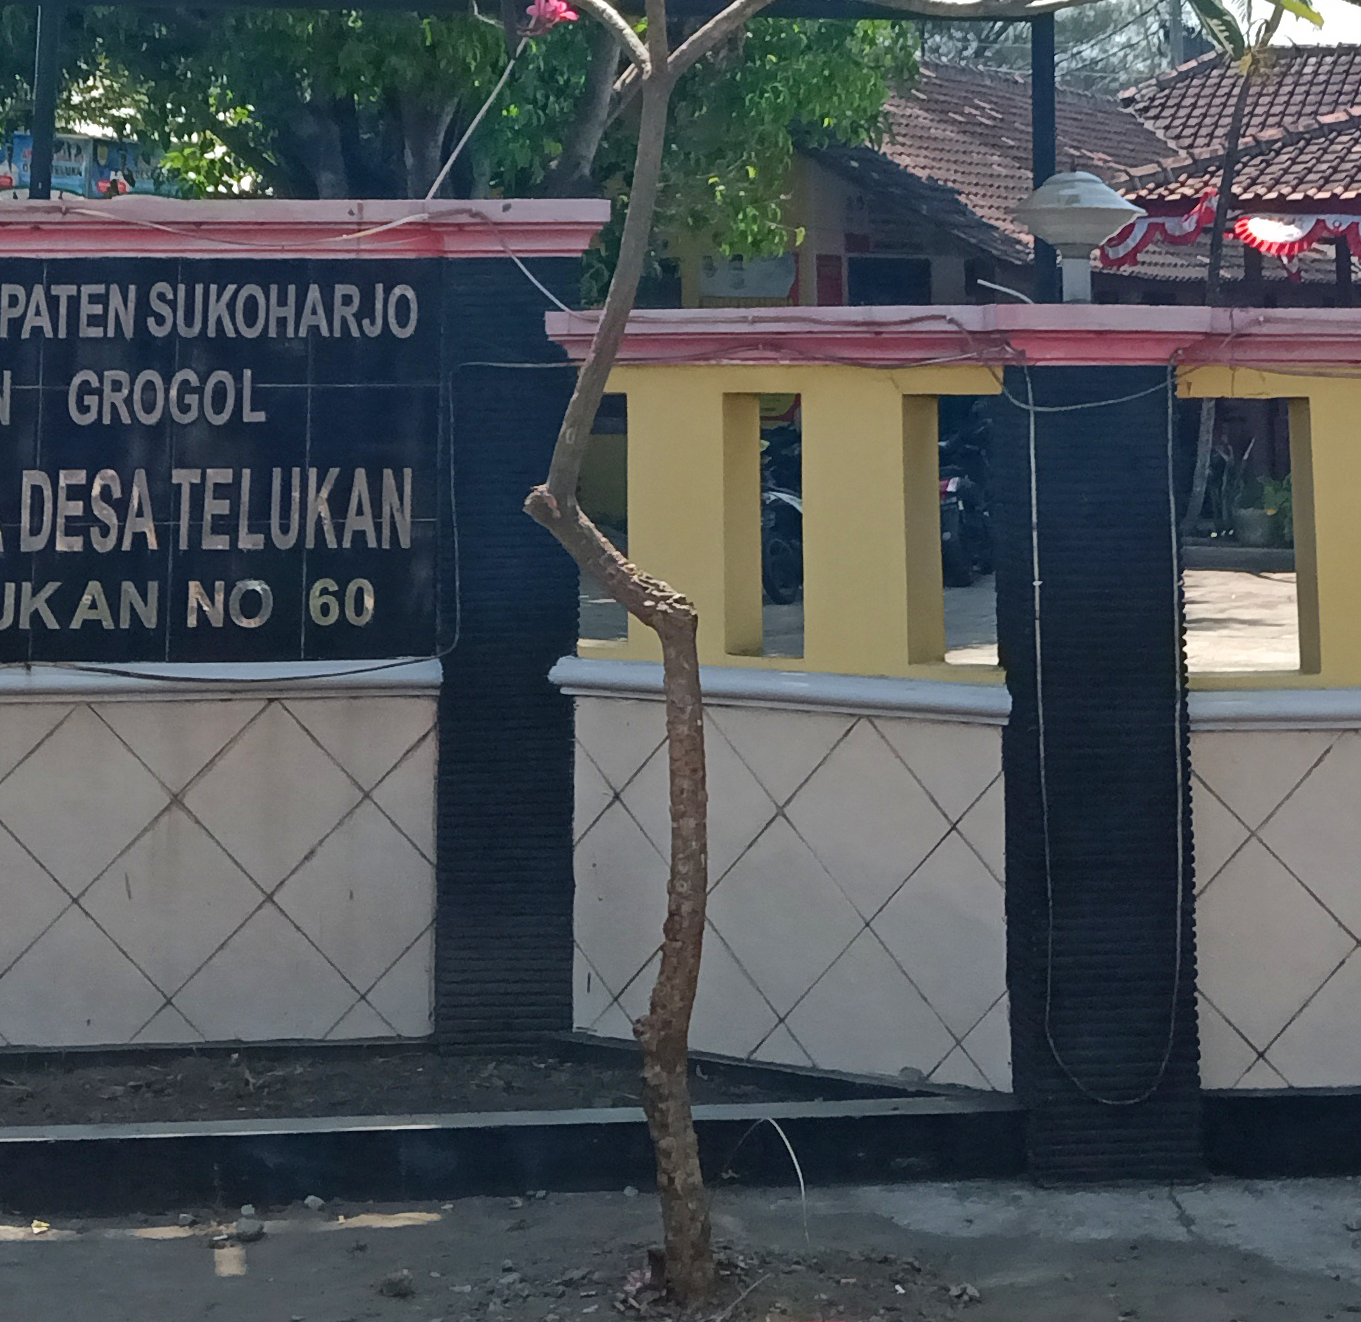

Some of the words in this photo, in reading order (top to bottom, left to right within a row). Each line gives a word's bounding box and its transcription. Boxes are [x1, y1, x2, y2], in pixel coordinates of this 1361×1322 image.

[147, 282, 417, 338] SUKOHARJO
[69, 369, 268, 425] GROGOL
[21, 469, 157, 552] DESA
[172, 467, 412, 552] TELUKAN
[187, 580, 272, 628] NO
[309, 578, 374, 625] 60
